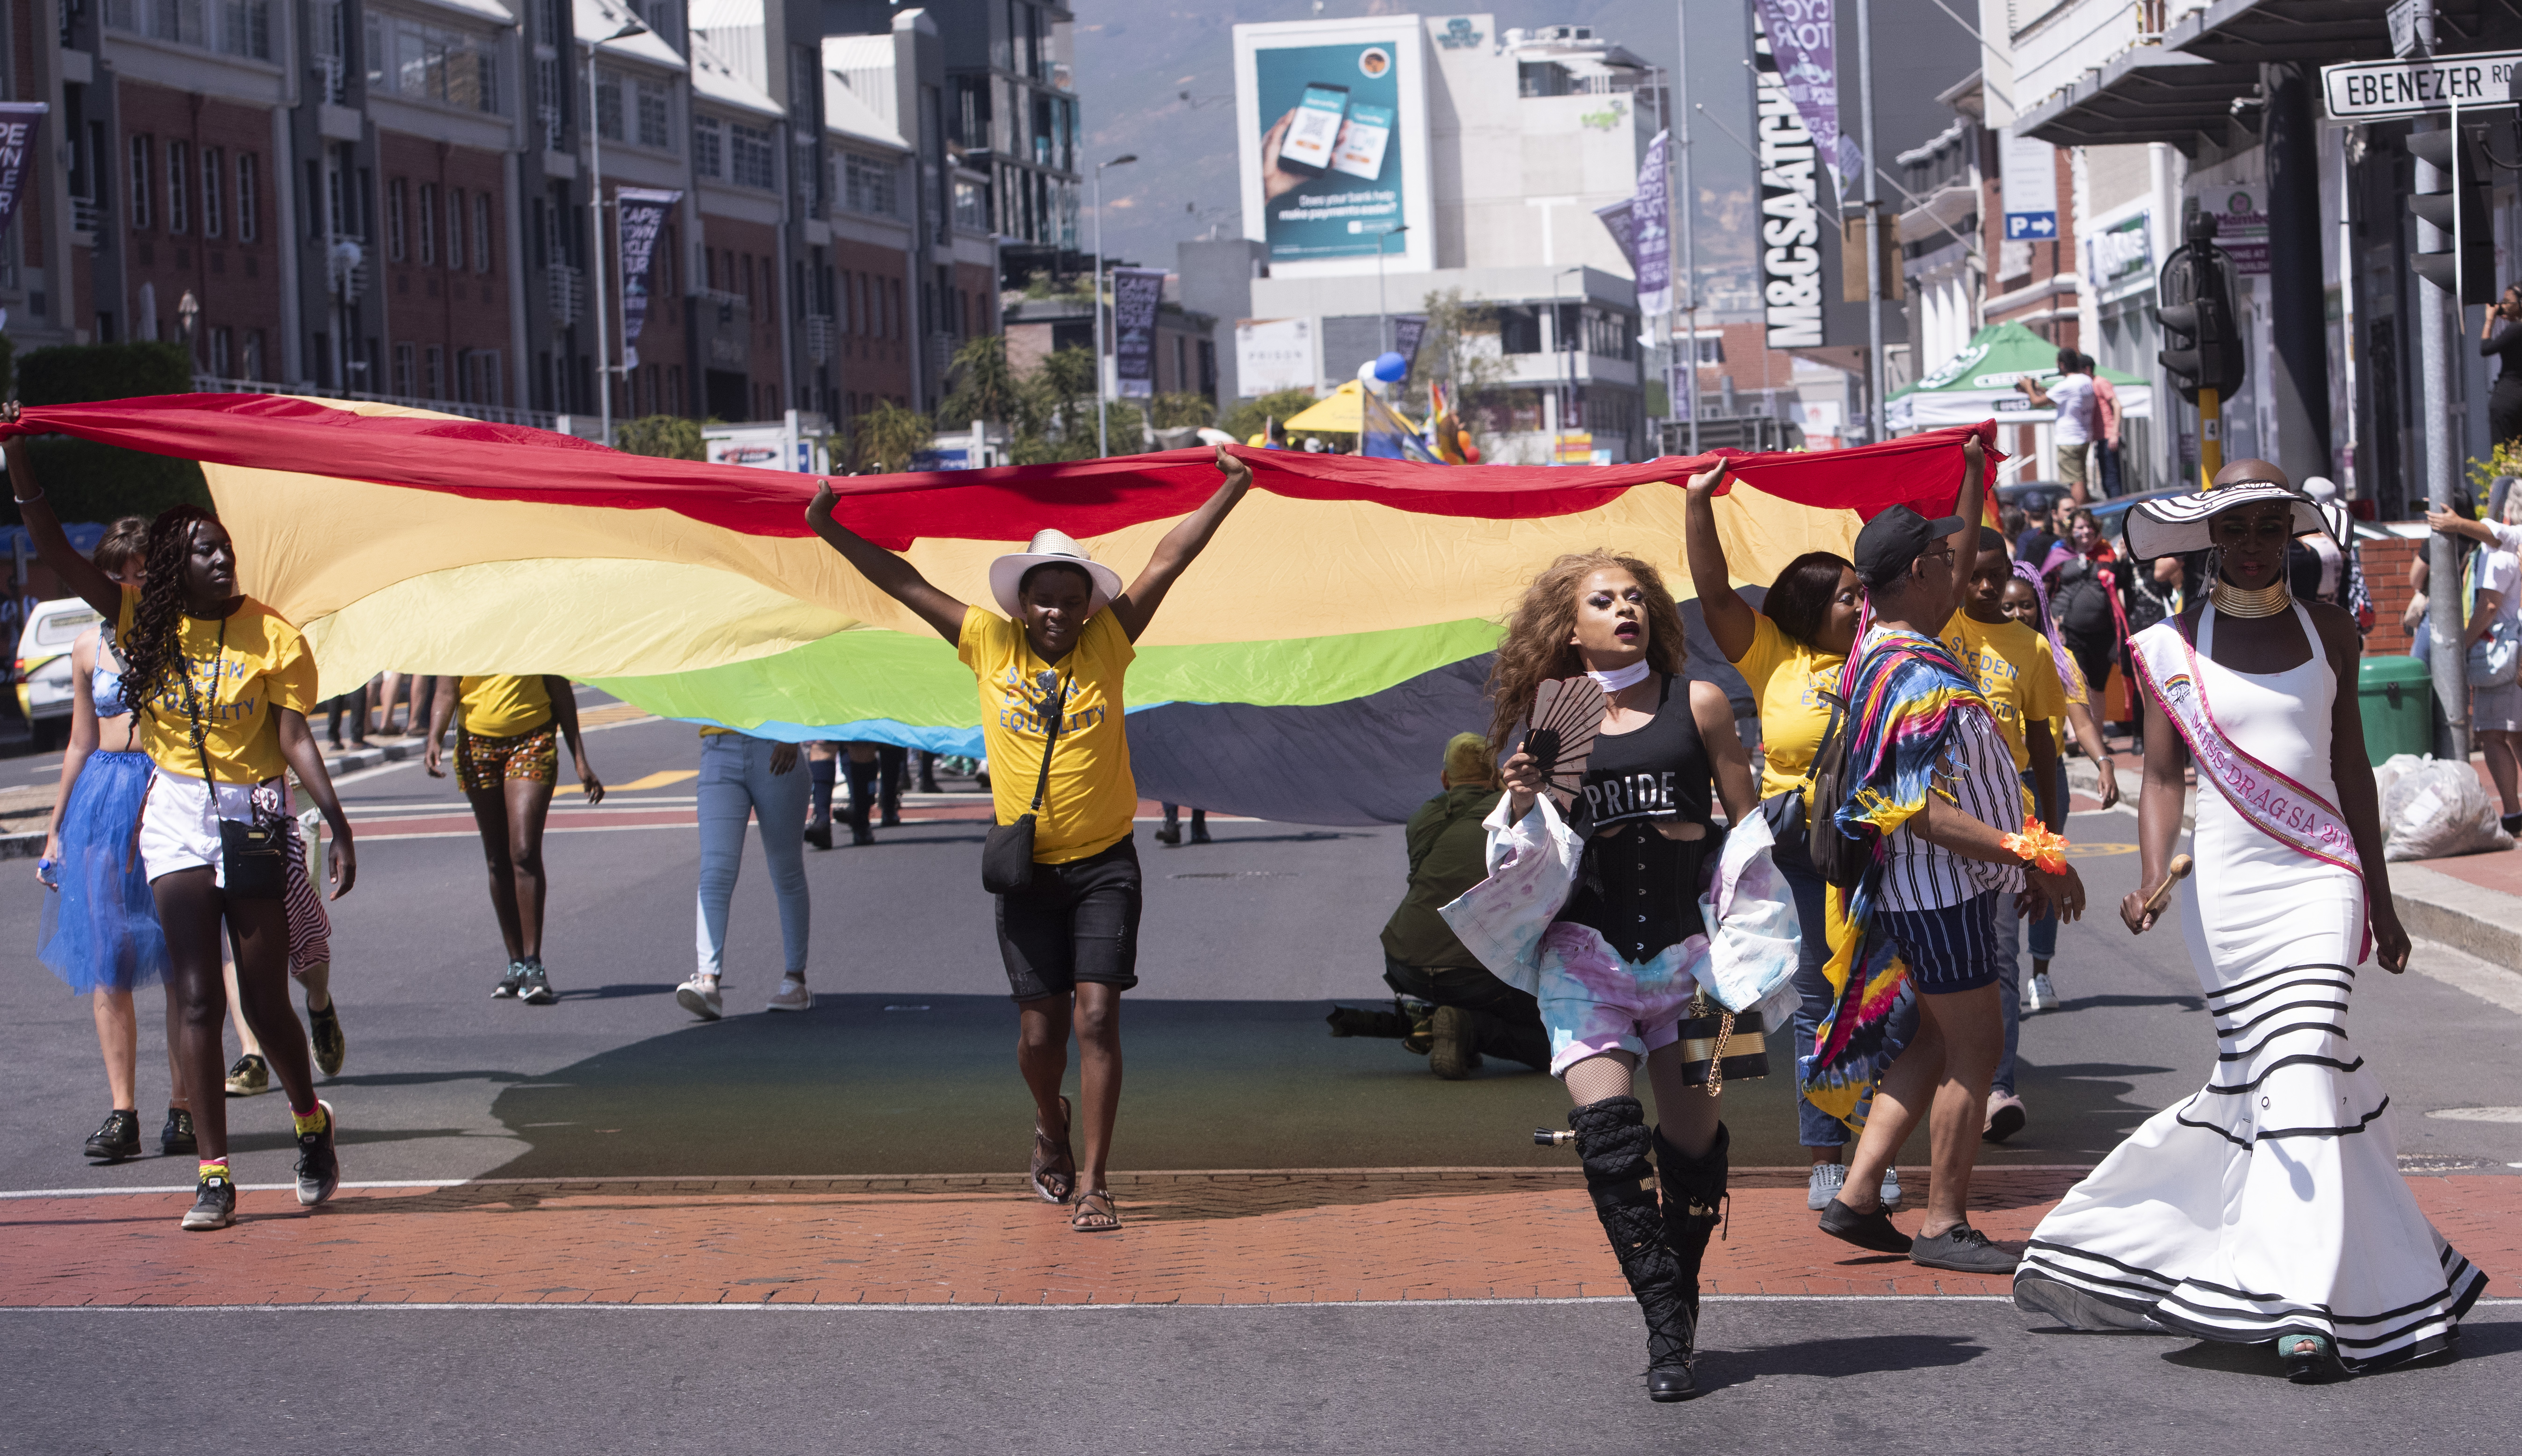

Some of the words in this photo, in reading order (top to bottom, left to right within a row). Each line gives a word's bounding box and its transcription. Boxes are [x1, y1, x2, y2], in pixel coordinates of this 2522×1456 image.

[2347, 66, 2482, 106] EBENEZER
[2493, 64, 2513, 83] RD
[1583, 772, 1675, 819] PRIDE
[2190, 708, 2227, 769] MISS
[2224, 764, 2289, 820] DRAG
[2286, 806, 2316, 838] SA
